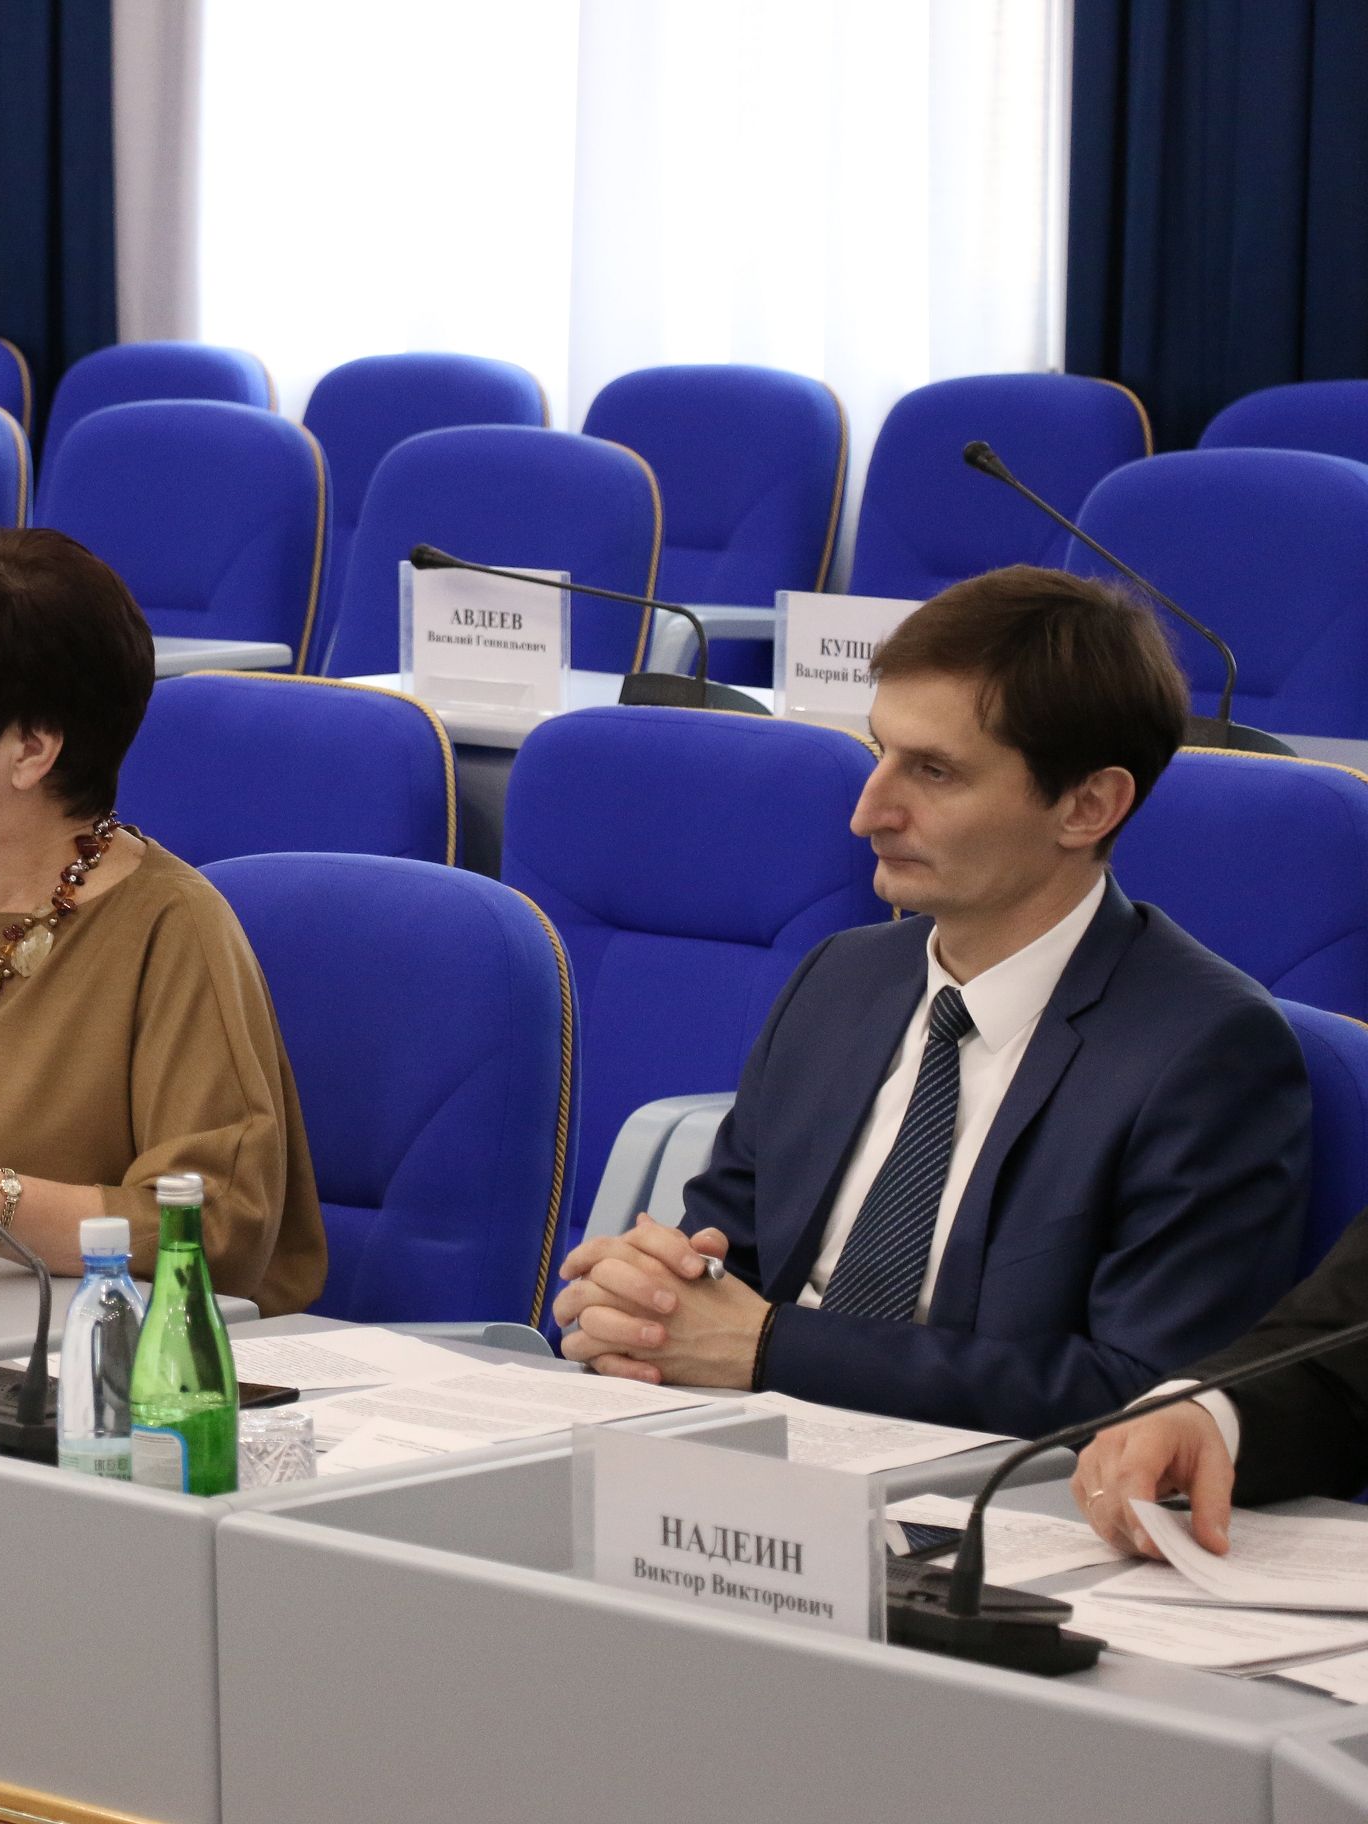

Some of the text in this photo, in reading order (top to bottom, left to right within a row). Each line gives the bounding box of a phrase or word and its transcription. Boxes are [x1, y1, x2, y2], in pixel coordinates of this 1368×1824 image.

[451, 608, 523, 630] АВДЕЕВ
[428, 630, 473, 646] Василий
[820, 638, 875, 660] КУПЦ
[795, 662, 849, 684] Валерий
[660, 1514, 804, 1575] НАДЕИН
[633, 1556, 834, 1620] Виктор Викторович
